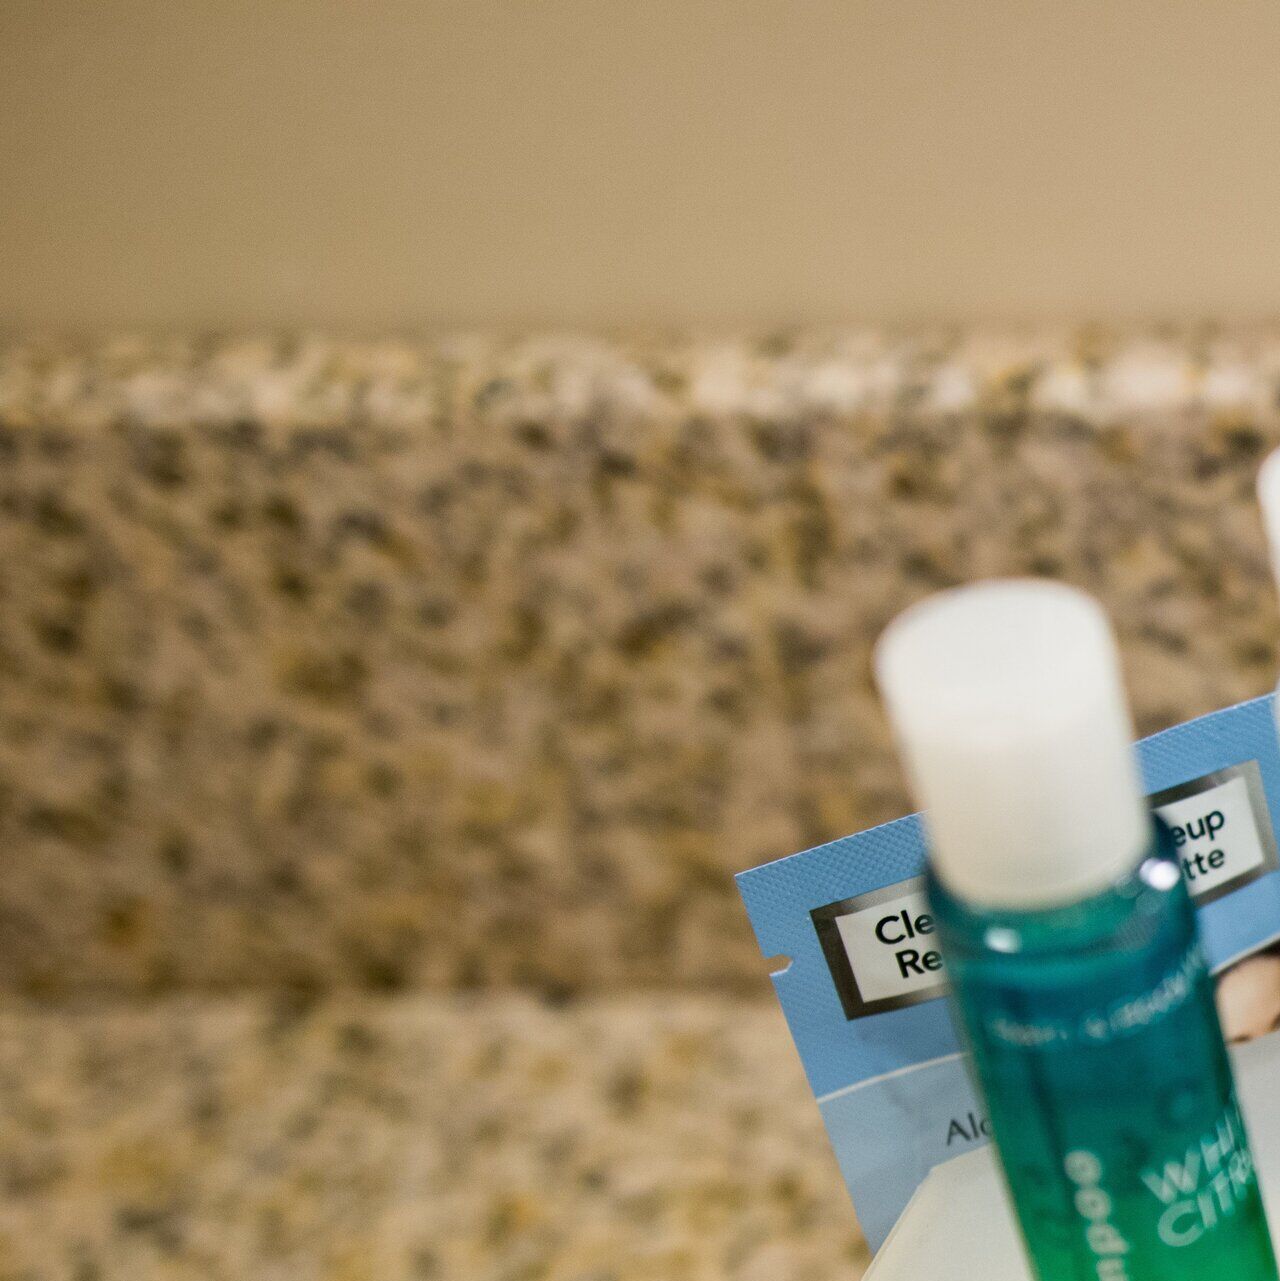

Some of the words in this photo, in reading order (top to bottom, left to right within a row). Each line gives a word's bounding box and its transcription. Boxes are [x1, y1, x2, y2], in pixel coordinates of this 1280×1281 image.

[875, 910, 936, 945] Cle
[1170, 811, 1225, 847] eup
[895, 949, 943, 979] Re
[1183, 849, 1225, 880] tte
[1140, 1110, 1241, 1203] WHI
[1157, 1148, 1250, 1247] CITR
